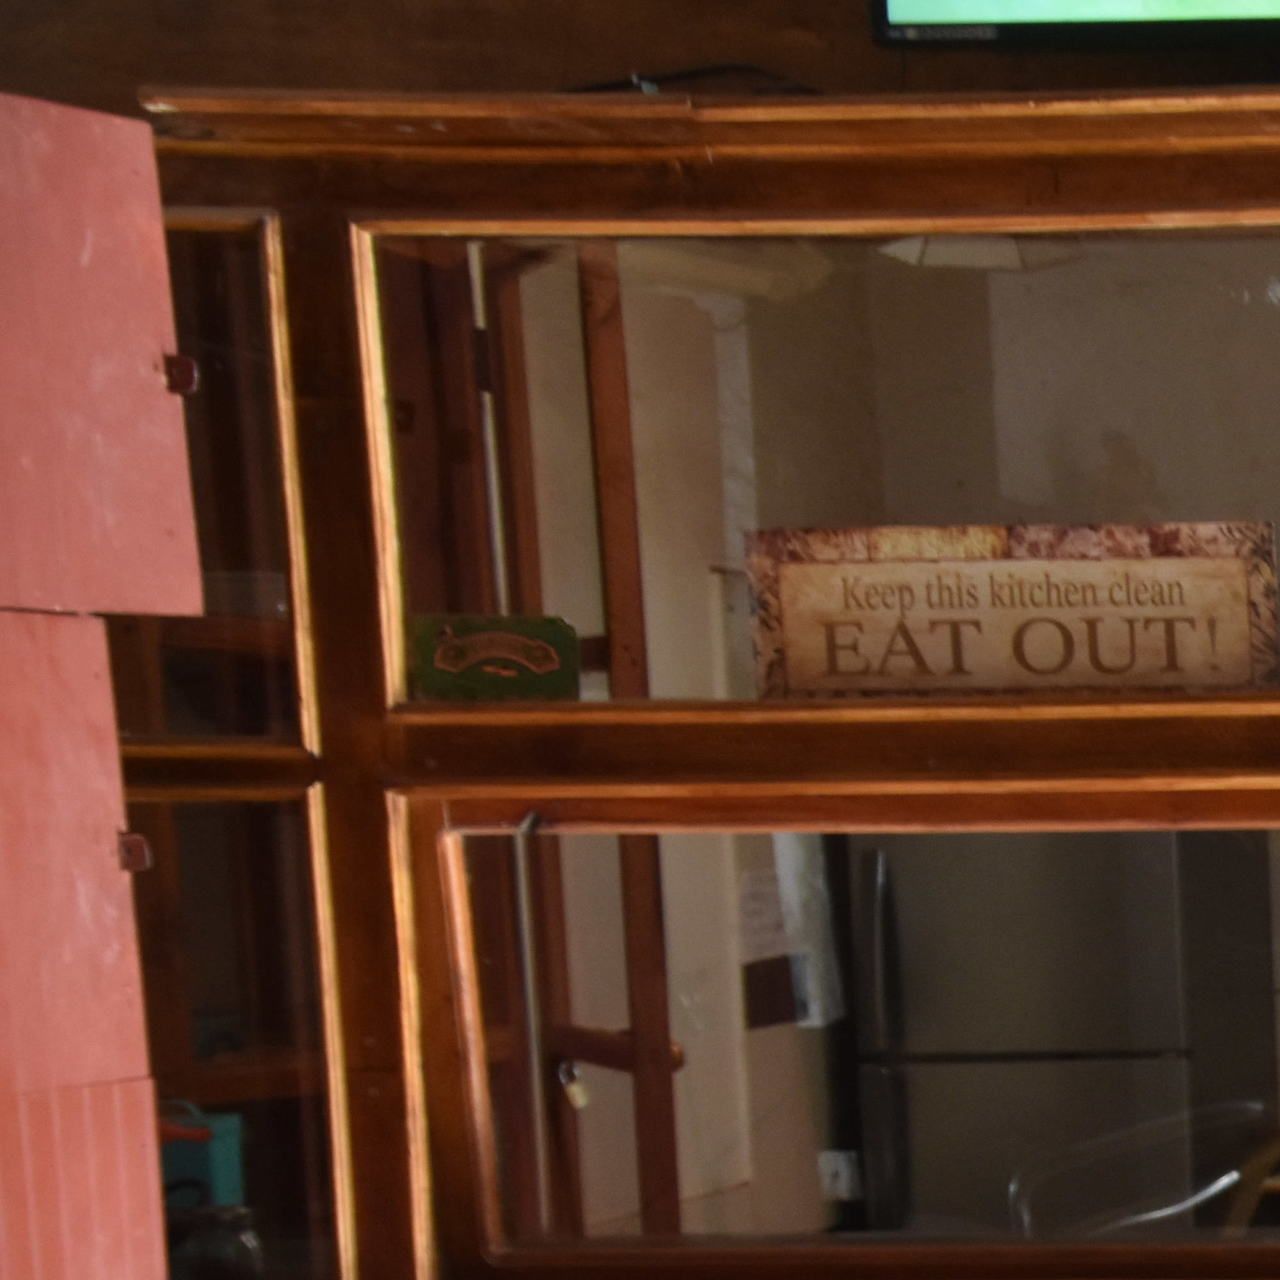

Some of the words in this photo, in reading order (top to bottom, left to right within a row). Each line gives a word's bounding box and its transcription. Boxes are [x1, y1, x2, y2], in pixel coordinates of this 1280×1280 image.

[841, 574, 915, 620] Keep
[926, 572, 980, 609] this
[988, 572, 1099, 608] kitchen
[1108, 571, 1185, 608] clean
[822, 618, 983, 677] EAT
[1011, 615, 1222, 675] OUT!
